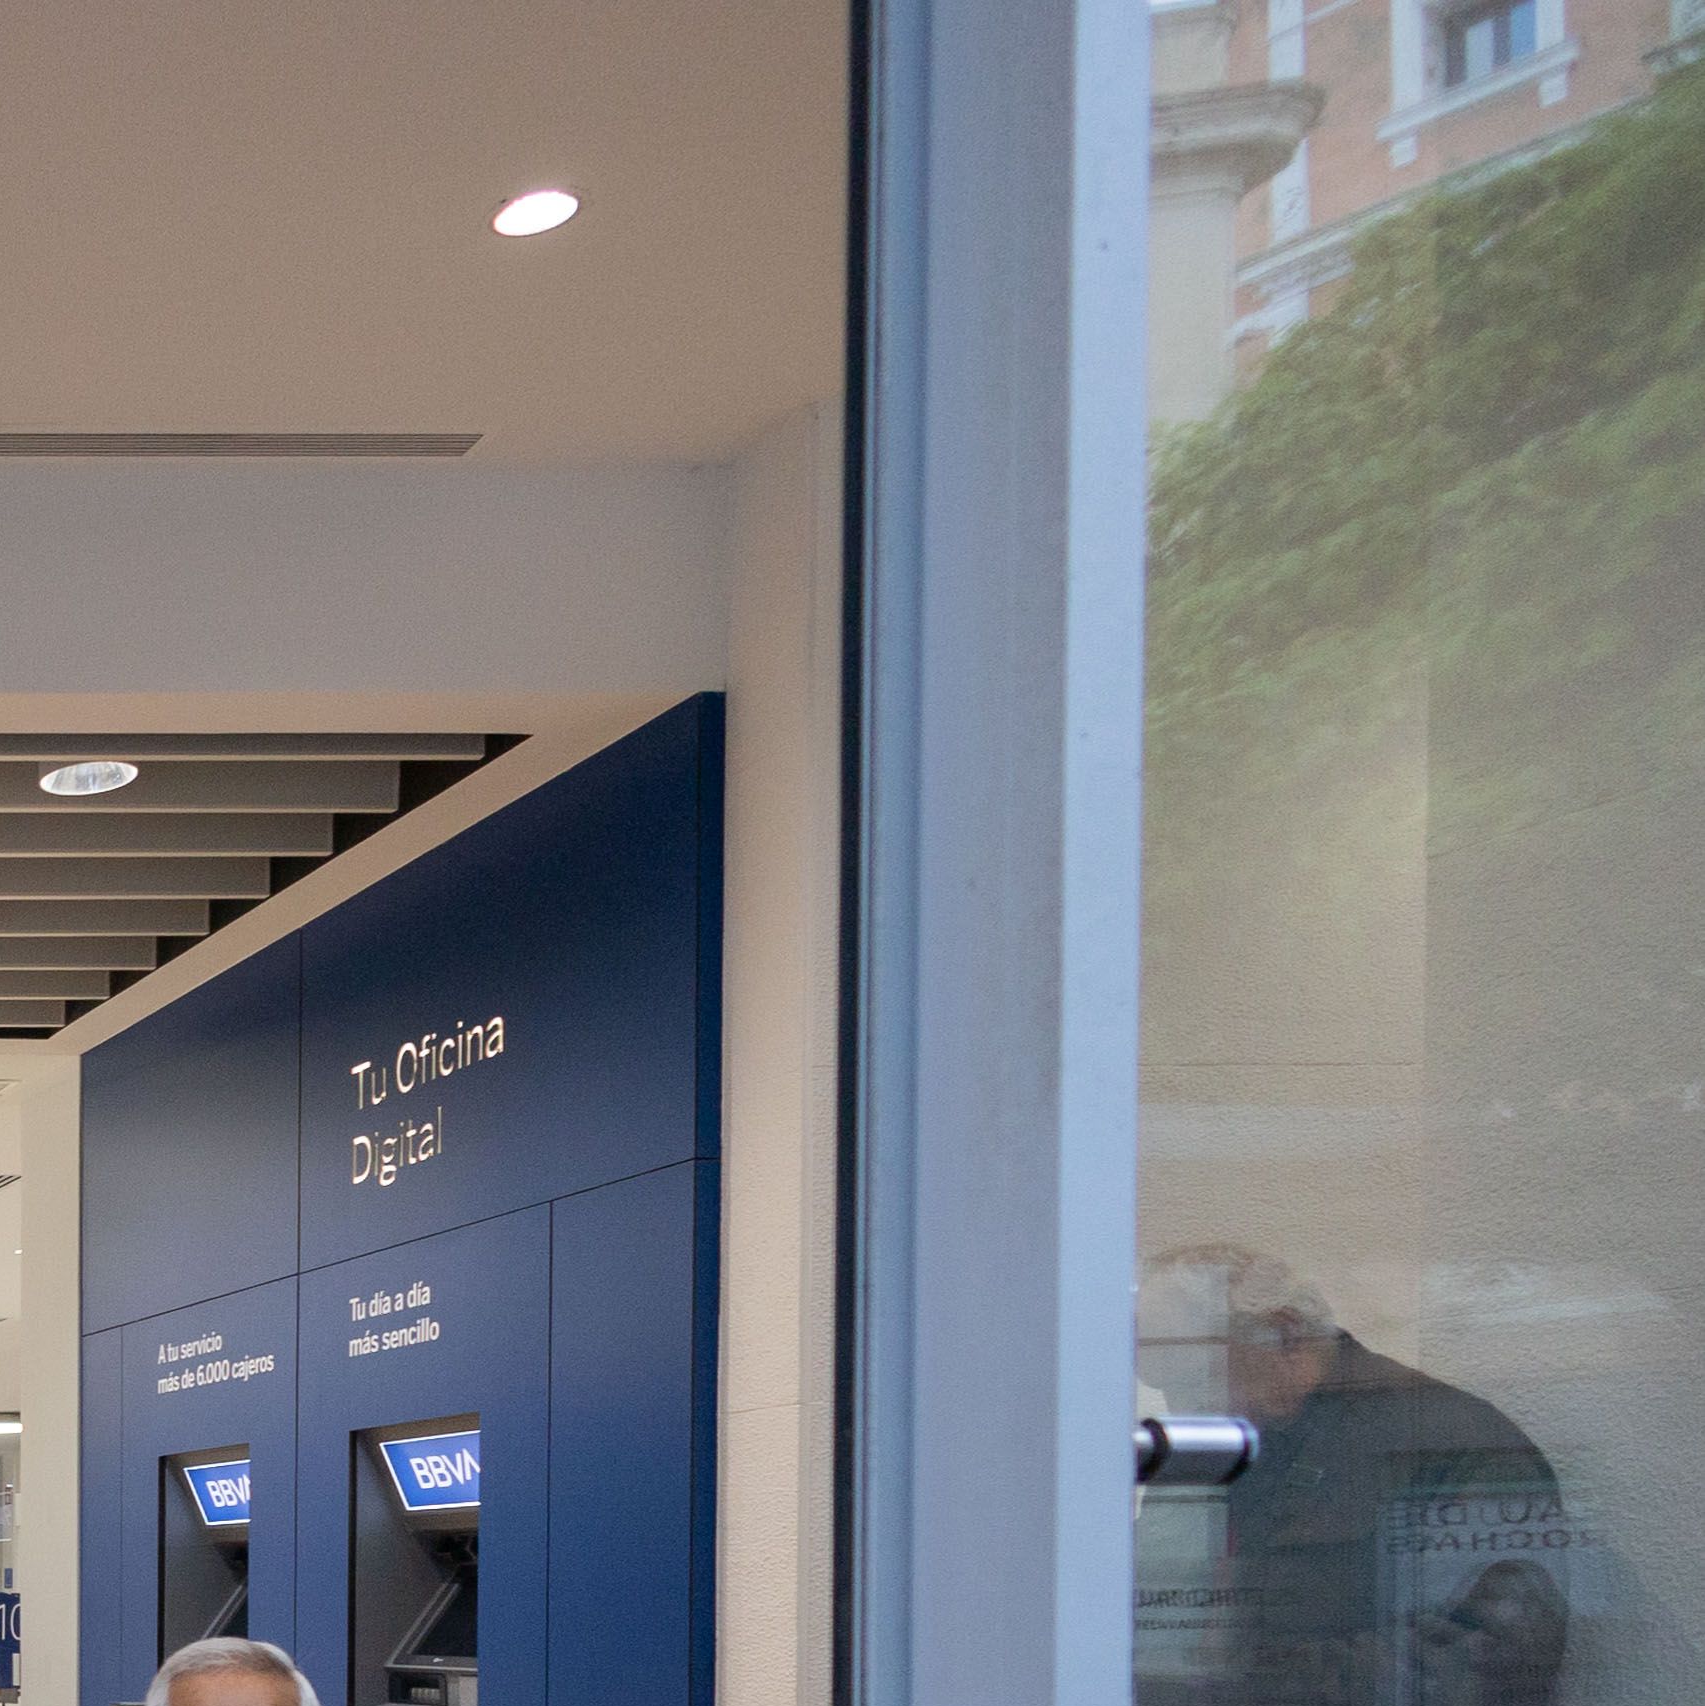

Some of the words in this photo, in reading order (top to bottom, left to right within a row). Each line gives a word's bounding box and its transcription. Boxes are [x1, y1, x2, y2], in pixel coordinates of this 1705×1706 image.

[350, 1061, 387, 1110] Tu
[395, 1016, 504, 1093] Oficina
[351, 1106, 442, 1187] Digital
[349, 1296, 366, 1322] Tu
[369, 1290, 391, 1317] día
[394, 1292, 404, 1312] a
[407, 1280, 431, 1308] día
[157, 1344, 167, 1365] A
[167, 1343, 179, 1362] tu
[180, 1331, 223, 1359] servicio
[349, 1329, 379, 1358] más
[381, 1316, 440, 1351] sencillo
[157, 1371, 180, 1394] más
[181, 1368, 195, 1389] de
[196, 1359, 230, 1386] 6.000
[231, 1355, 275, 1382] cajeros
[409, 1447, 481, 1490] BBVA
